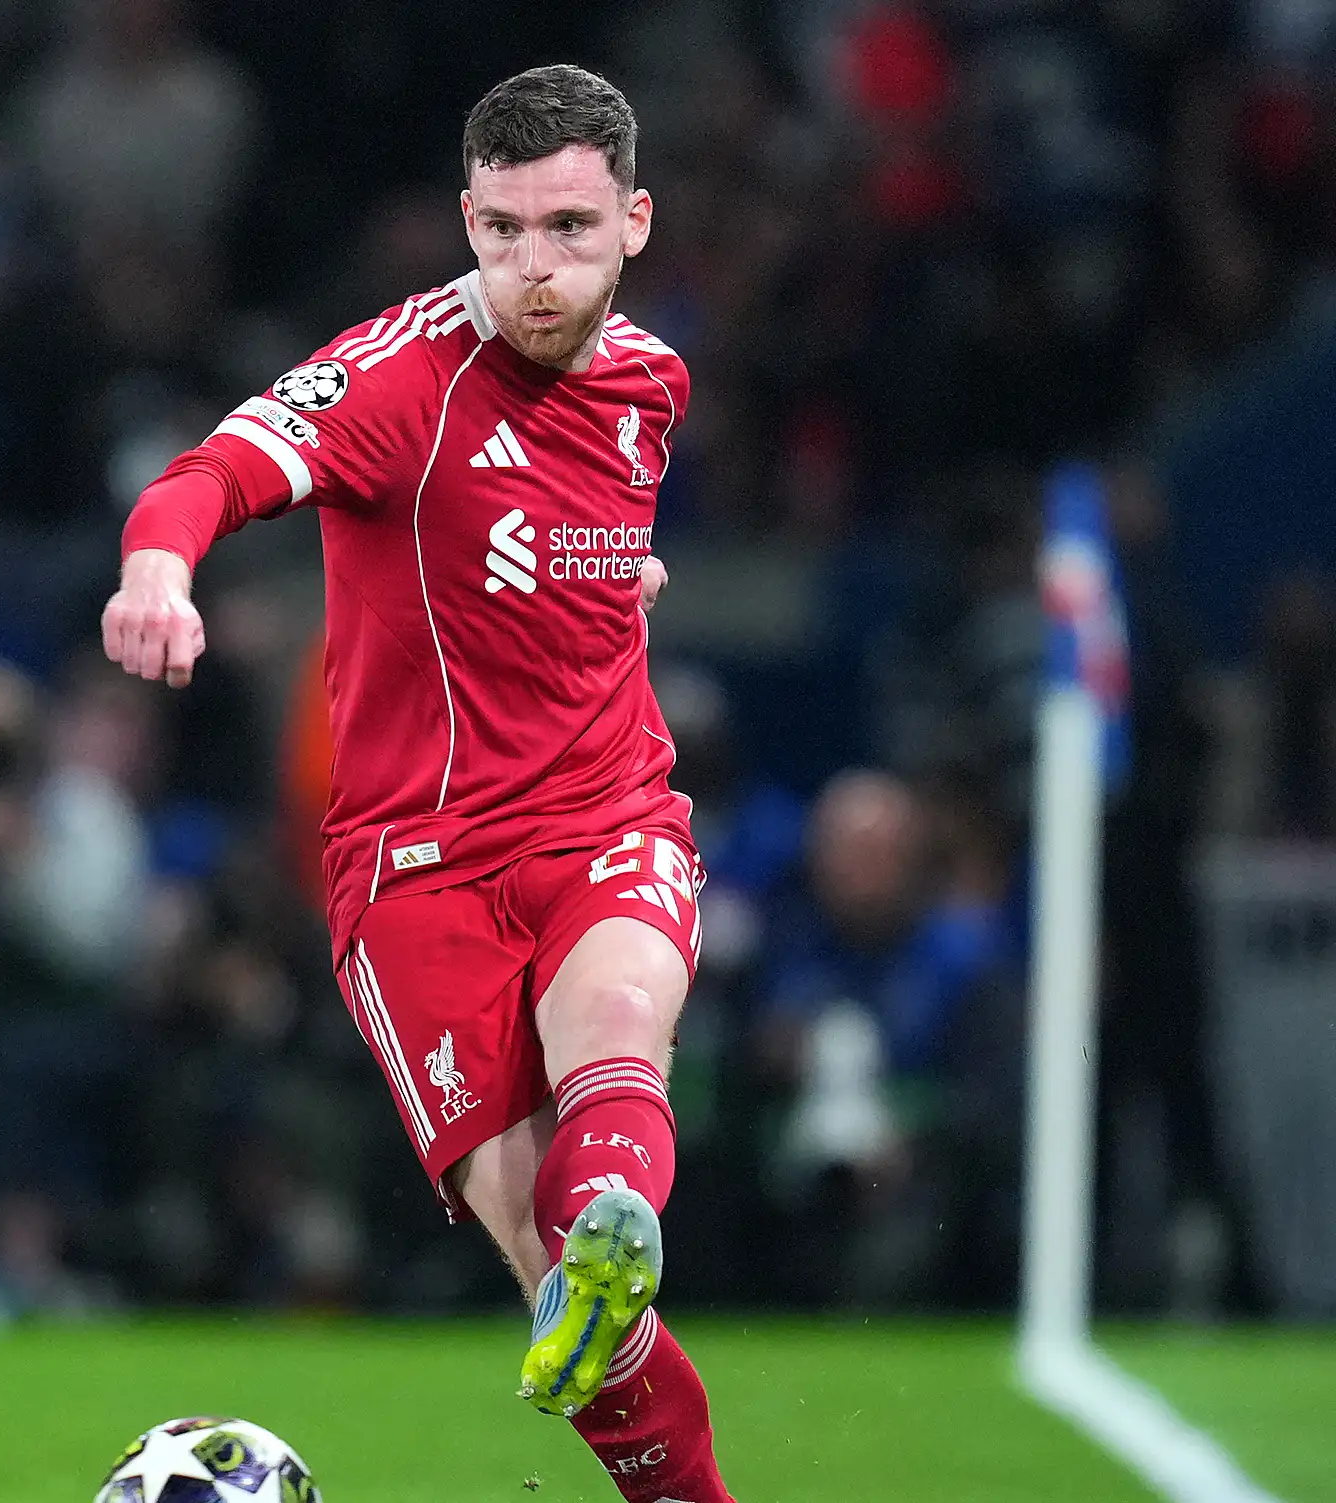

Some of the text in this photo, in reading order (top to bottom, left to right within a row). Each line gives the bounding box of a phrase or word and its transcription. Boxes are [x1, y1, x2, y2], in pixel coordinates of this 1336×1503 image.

[548, 520, 654, 551] standard
[548, 551, 645, 580] chartere
[588, 831, 694, 906] 26
[440, 1091, 482, 1125] L.F.C.
[580, 1132, 652, 1170] LFC
